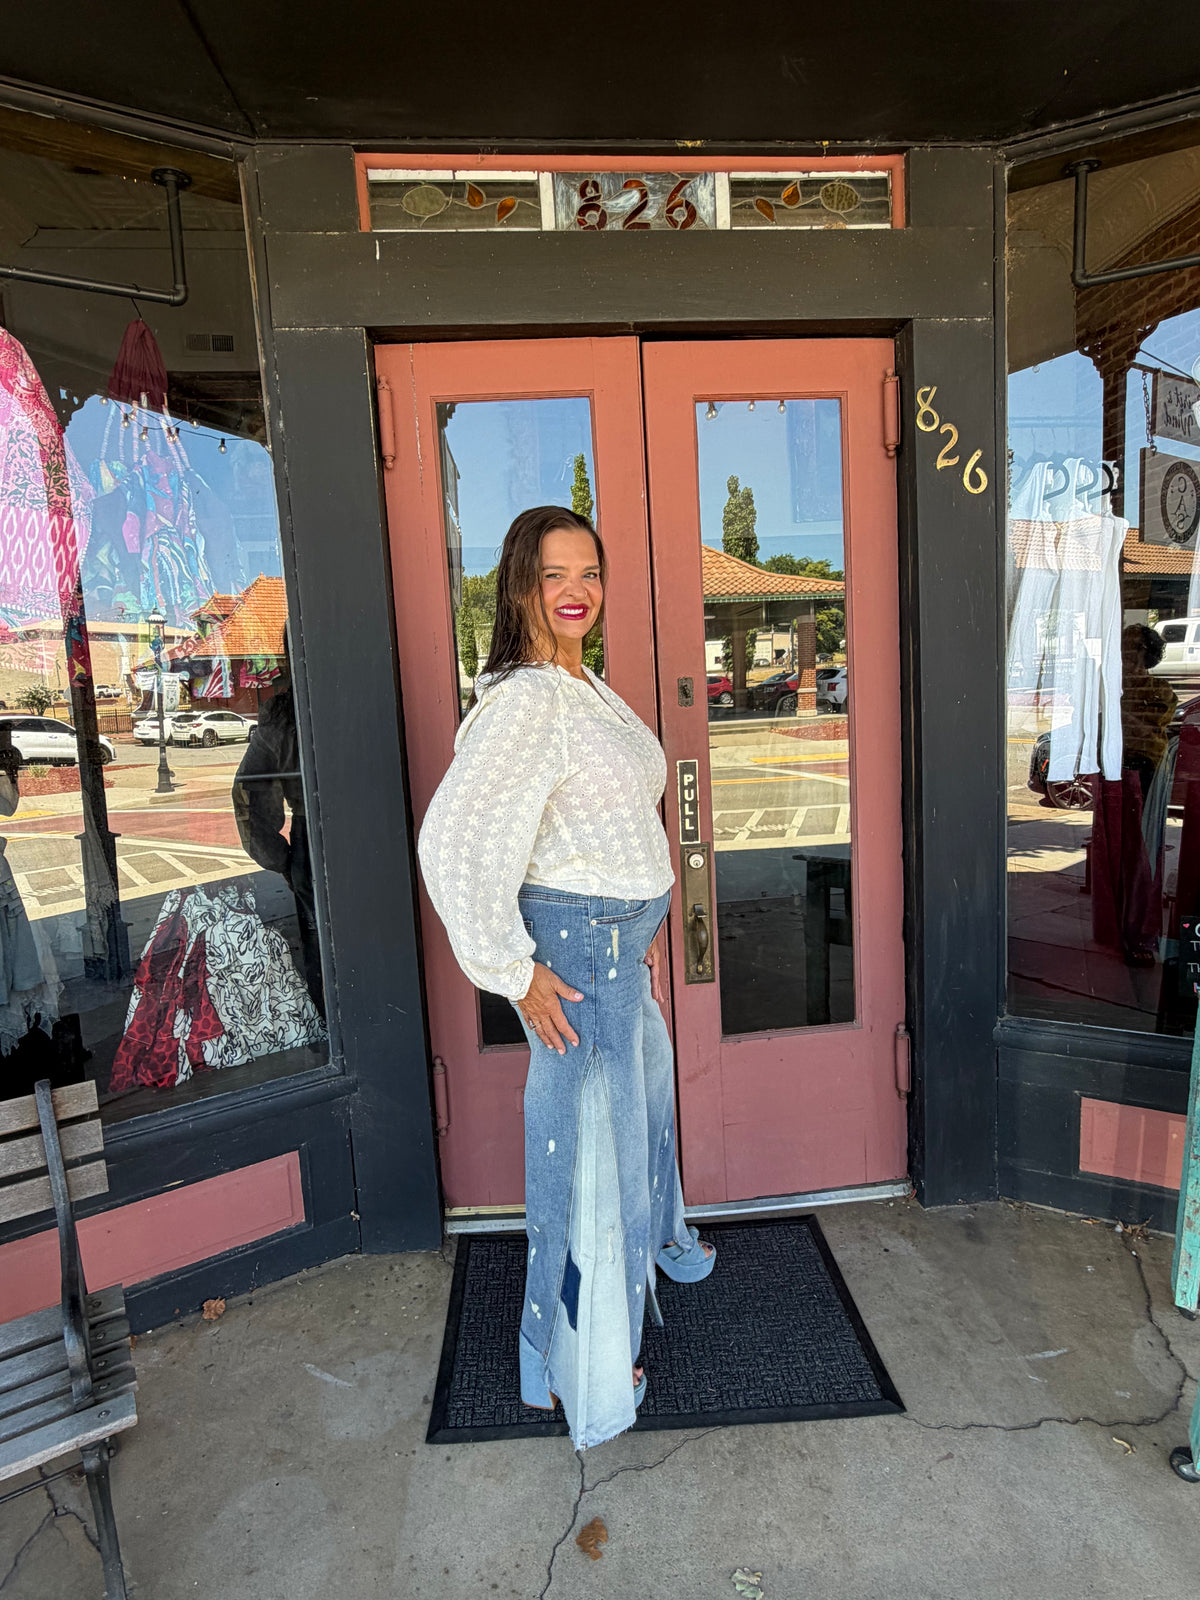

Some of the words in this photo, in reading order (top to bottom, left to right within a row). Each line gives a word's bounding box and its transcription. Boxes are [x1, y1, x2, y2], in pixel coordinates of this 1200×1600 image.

[577, 178, 696, 230] 826
[916, 386, 988, 494] 826
[683, 774, 695, 830] PULL
